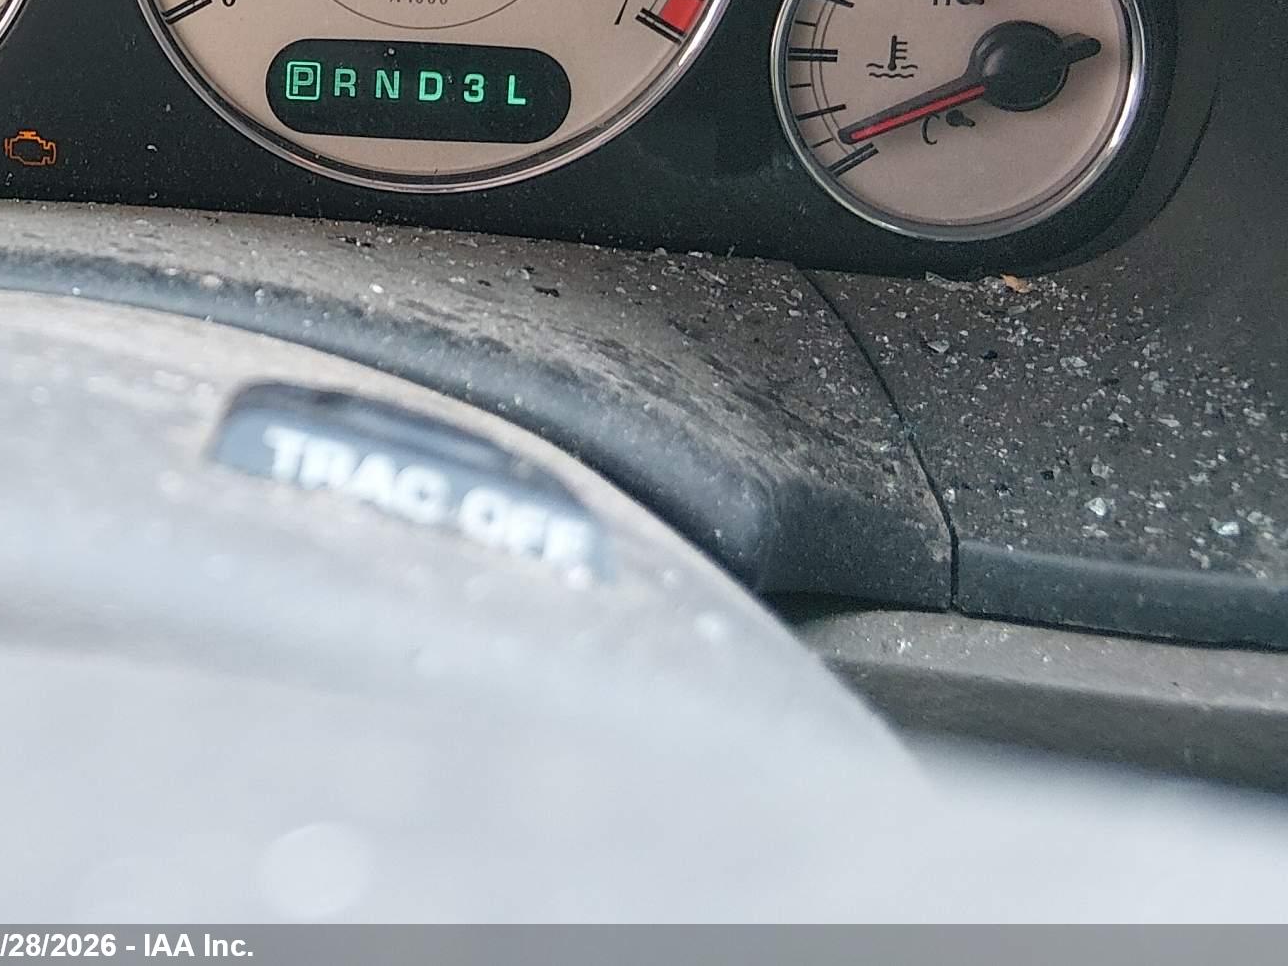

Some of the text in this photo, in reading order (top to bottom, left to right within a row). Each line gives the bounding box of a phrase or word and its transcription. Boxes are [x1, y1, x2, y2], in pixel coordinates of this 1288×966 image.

[293, 66, 526, 105] P R N D 3 L
